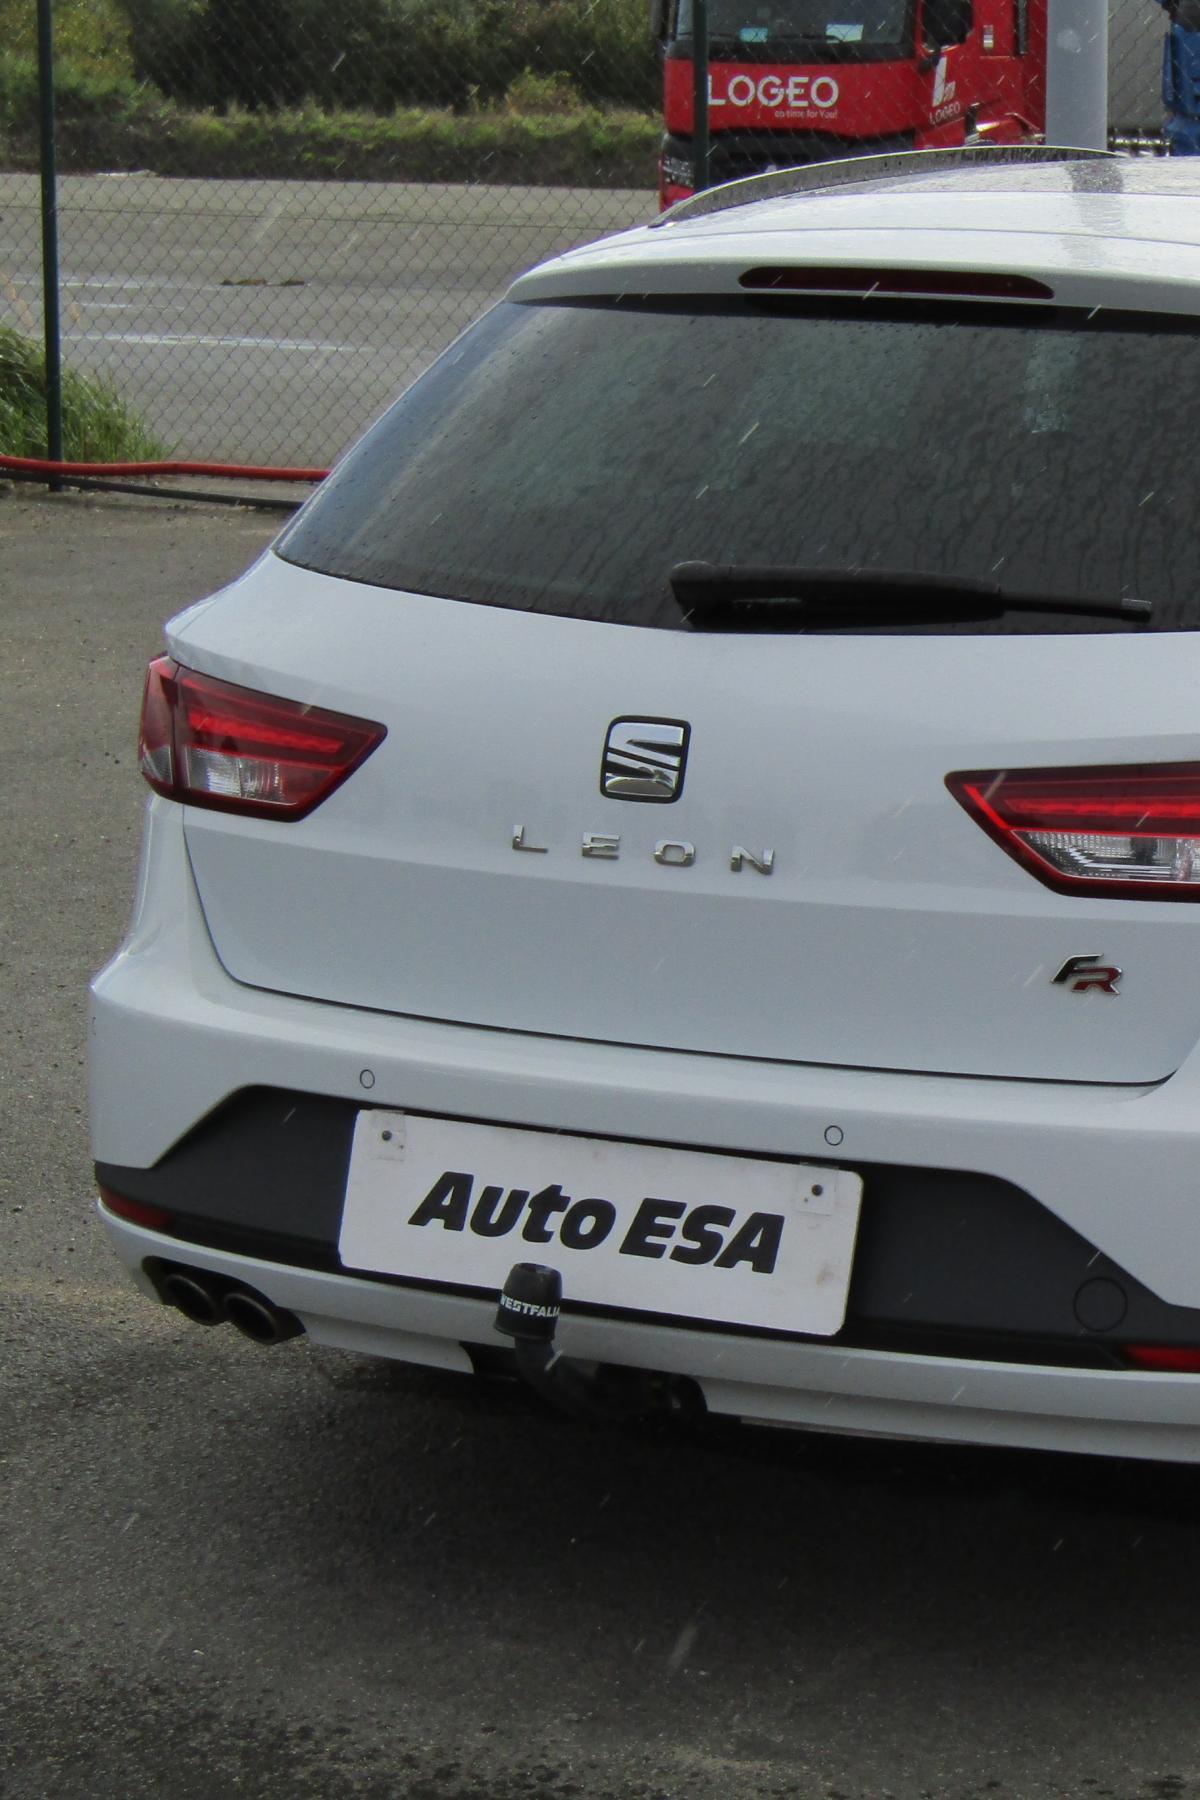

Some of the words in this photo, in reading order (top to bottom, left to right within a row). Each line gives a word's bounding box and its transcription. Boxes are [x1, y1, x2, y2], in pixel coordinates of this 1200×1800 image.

[707, 74, 839, 107] LOGEO
[512, 824, 775, 876] LEON
[1050, 953, 1122, 995] FR
[407, 1171, 617, 1250] Auto
[619, 1197, 786, 1274] ESA
